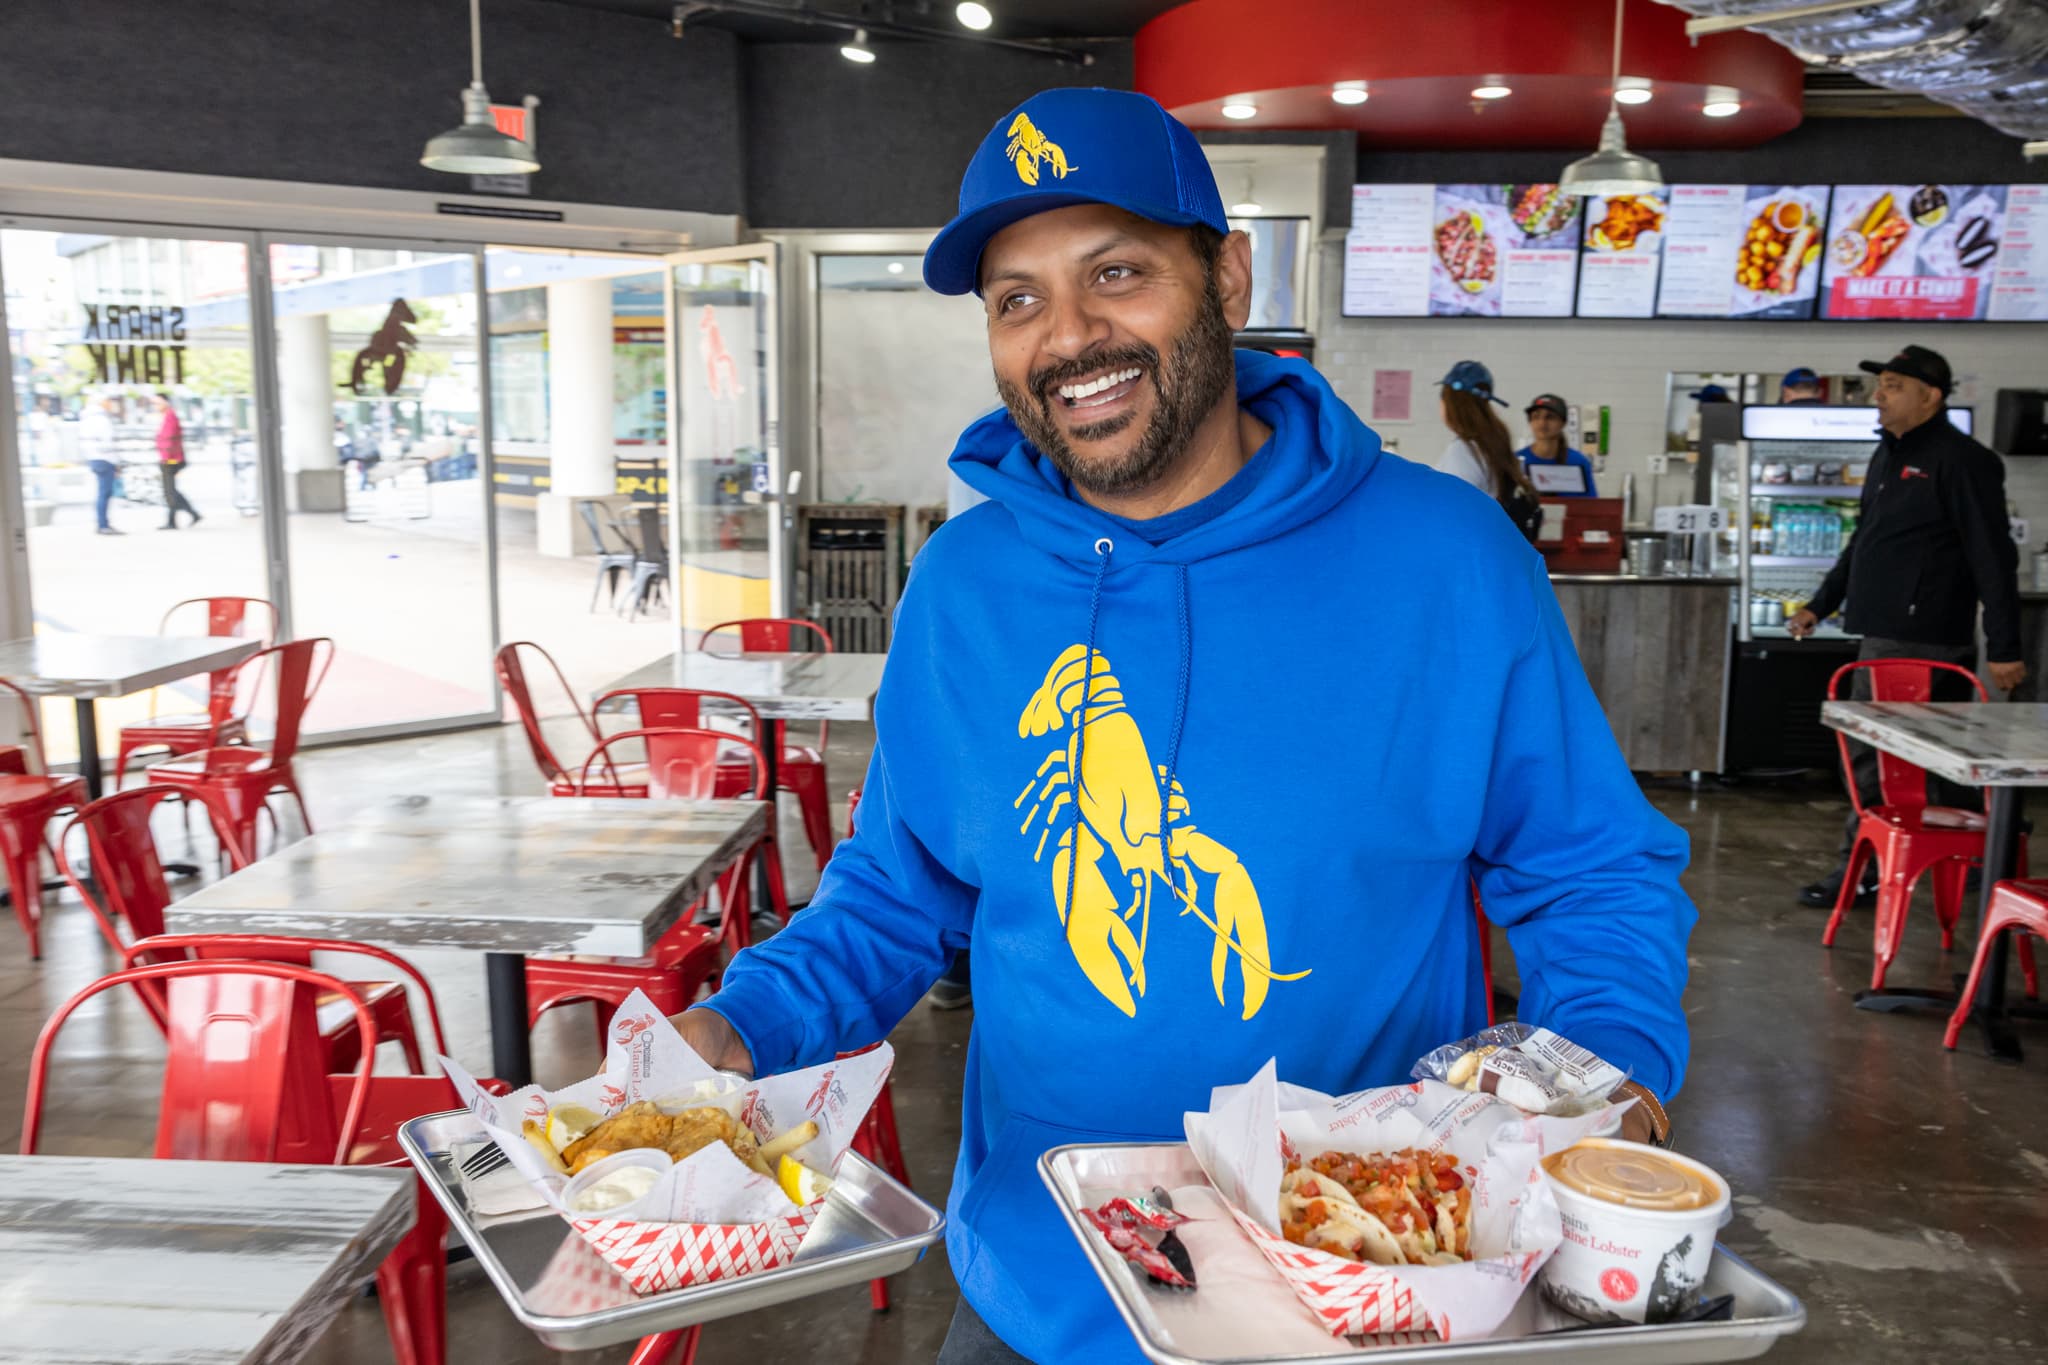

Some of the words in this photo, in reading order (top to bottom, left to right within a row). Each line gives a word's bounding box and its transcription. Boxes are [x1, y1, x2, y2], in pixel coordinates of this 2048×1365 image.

[1677, 513, 1696, 530] 21
[1709, 511, 1719, 529] 8
[631, 1043, 642, 1079] Maine
[1591, 1236, 1643, 1259] Lobster
